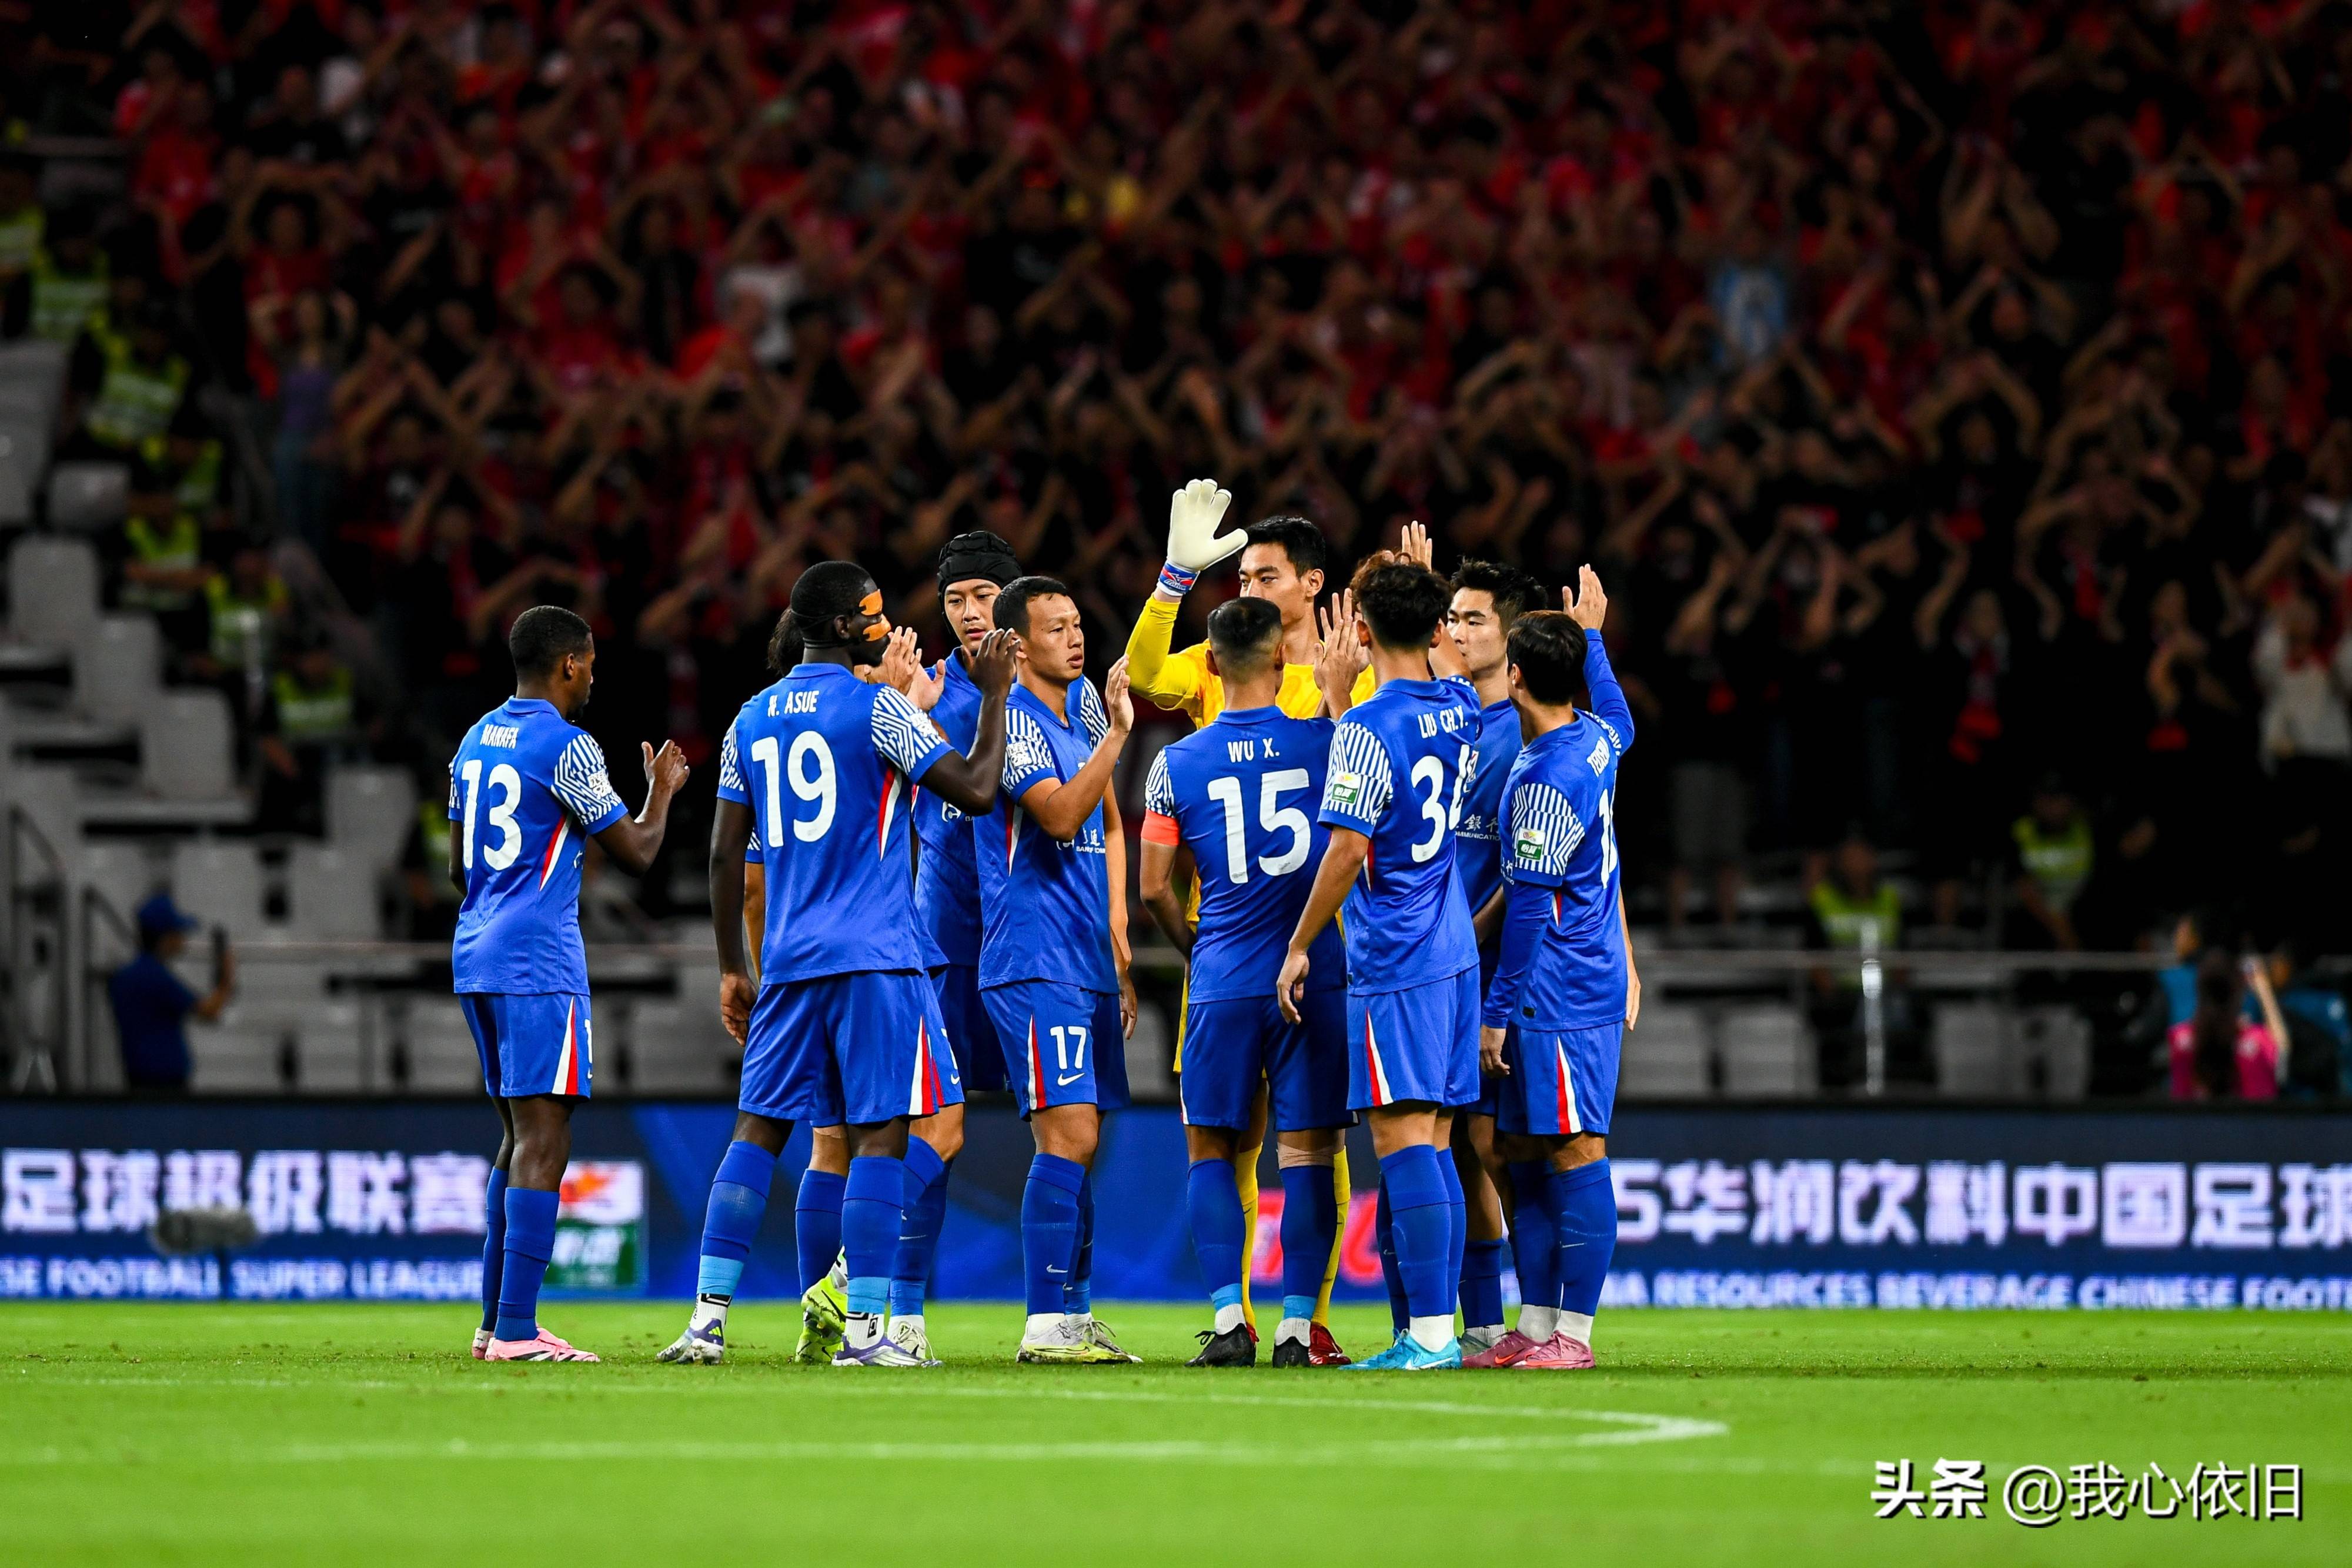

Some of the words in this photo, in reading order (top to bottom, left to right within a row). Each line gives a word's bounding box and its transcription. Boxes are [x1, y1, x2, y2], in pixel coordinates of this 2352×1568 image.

[767, 694, 780, 717] N.
[784, 690, 820, 715] ASUE
[479, 723, 519, 750] MANAFA
[1417, 713, 1437, 738] LIU
[1227, 740, 1254, 763] WU
[1262, 738, 1280, 758] X.
[751, 730, 837, 848] 19
[462, 759, 522, 871] 13
[1207, 768, 1311, 884] 15
[1050, 1025, 1087, 1069] 17
[46, 1258, 220, 1296] FOOTBALL
[230, 1259, 346, 1297] SUPER
[2241, 1276, 2352, 1310] FOOT
